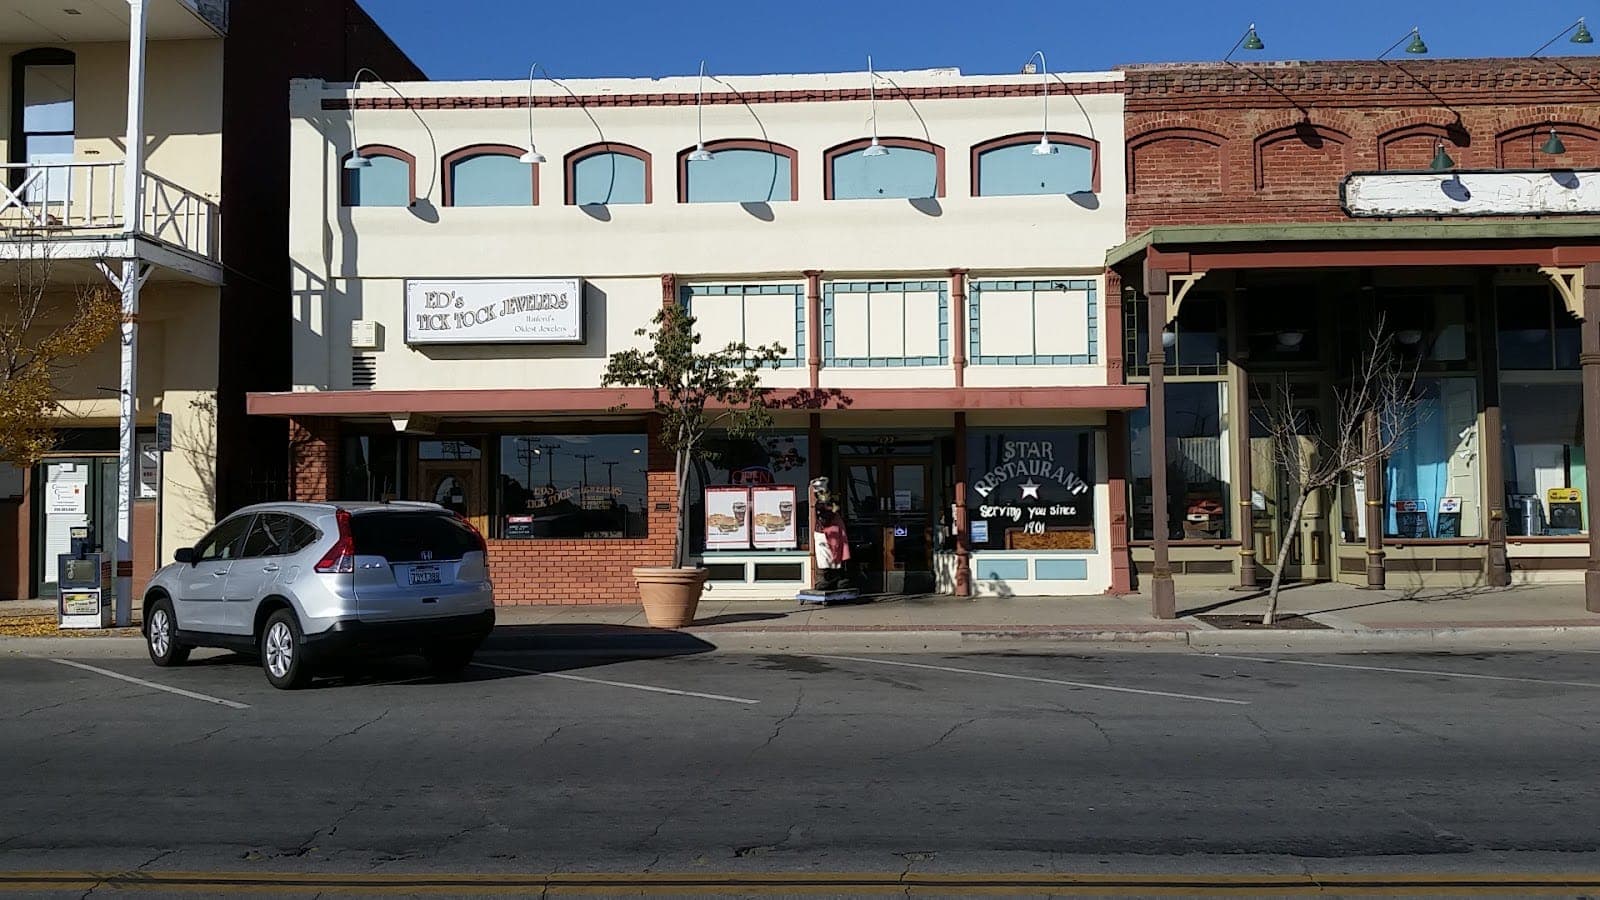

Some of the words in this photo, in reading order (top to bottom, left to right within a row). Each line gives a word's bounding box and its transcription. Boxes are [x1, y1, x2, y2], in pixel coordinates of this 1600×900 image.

[425, 291, 465, 309] ED's
[416, 313, 450, 331] TICK
[454, 303, 498, 329] TOCK
[500, 293, 569, 317] JEWELERS
[1003, 441, 1054, 462] STAR
[974, 460, 1089, 498] RESTAURANT
[979, 505, 1022, 522] Serving
[1027, 506, 1047, 519] you
[1049, 504, 1077, 516] since
[1023, 521, 1045, 535] 1901
